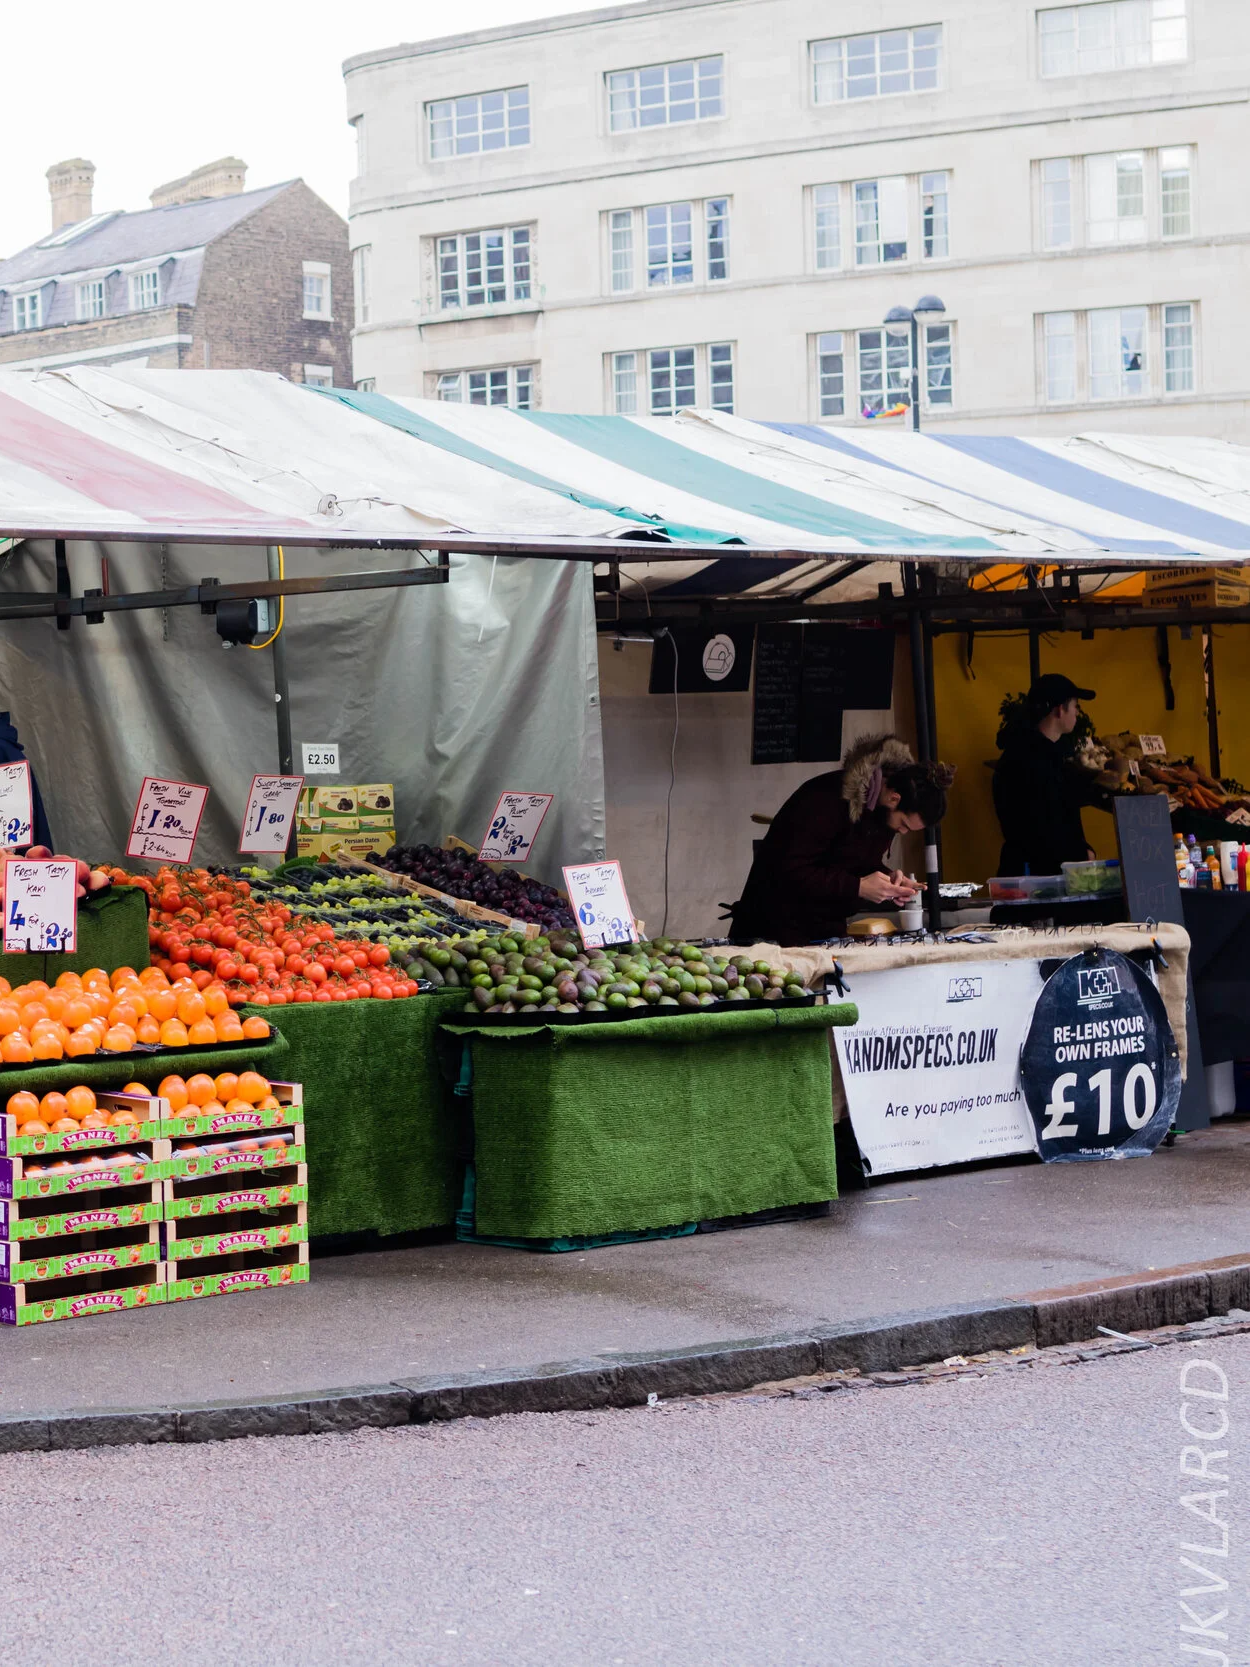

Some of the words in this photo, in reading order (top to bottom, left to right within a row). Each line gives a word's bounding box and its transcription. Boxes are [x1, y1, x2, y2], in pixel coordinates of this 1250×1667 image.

[308, 754, 335, 764] £2.50
[488, 816, 506, 840] 2
[14, 865, 38, 877] FRESH
[46, 864, 69, 880] TASTY
[26, 884, 46, 893] KAKI
[10, 900, 25, 930] 4
[579, 902, 595, 925] 6
[880, 1025, 920, 1037] Affordable
[923, 1025, 952, 1034] Eyewear
[1054, 1021, 1111, 1044] RE-LENS
[1111, 1016, 1145, 1036] YOUR
[844, 1028, 998, 1074] KANDMSPECS.CO.UK
[1055, 1043, 1091, 1063] OWN
[1094, 1036, 1145, 1058] FRAMES
[885, 1103, 908, 1117] Are
[915, 1103, 937, 1119] you
[940, 1098, 973, 1116] paying
[977, 1096, 991, 1105] too
[995, 1088, 1020, 1104] much
[217, 1114, 259, 1125] MANEL
[66, 1131, 113, 1143] MANEL
[219, 1154, 261, 1166] MANEL
[71, 1173, 118, 1185] MANEL
[223, 1194, 265, 1206] MANEL
[70, 1213, 116, 1226] MANEL
[223, 1234, 265, 1246] MANEL
[69, 1255, 114, 1268] MANEL
[225, 1274, 267, 1286] MANEL
[75, 1296, 121, 1308] MANEL
